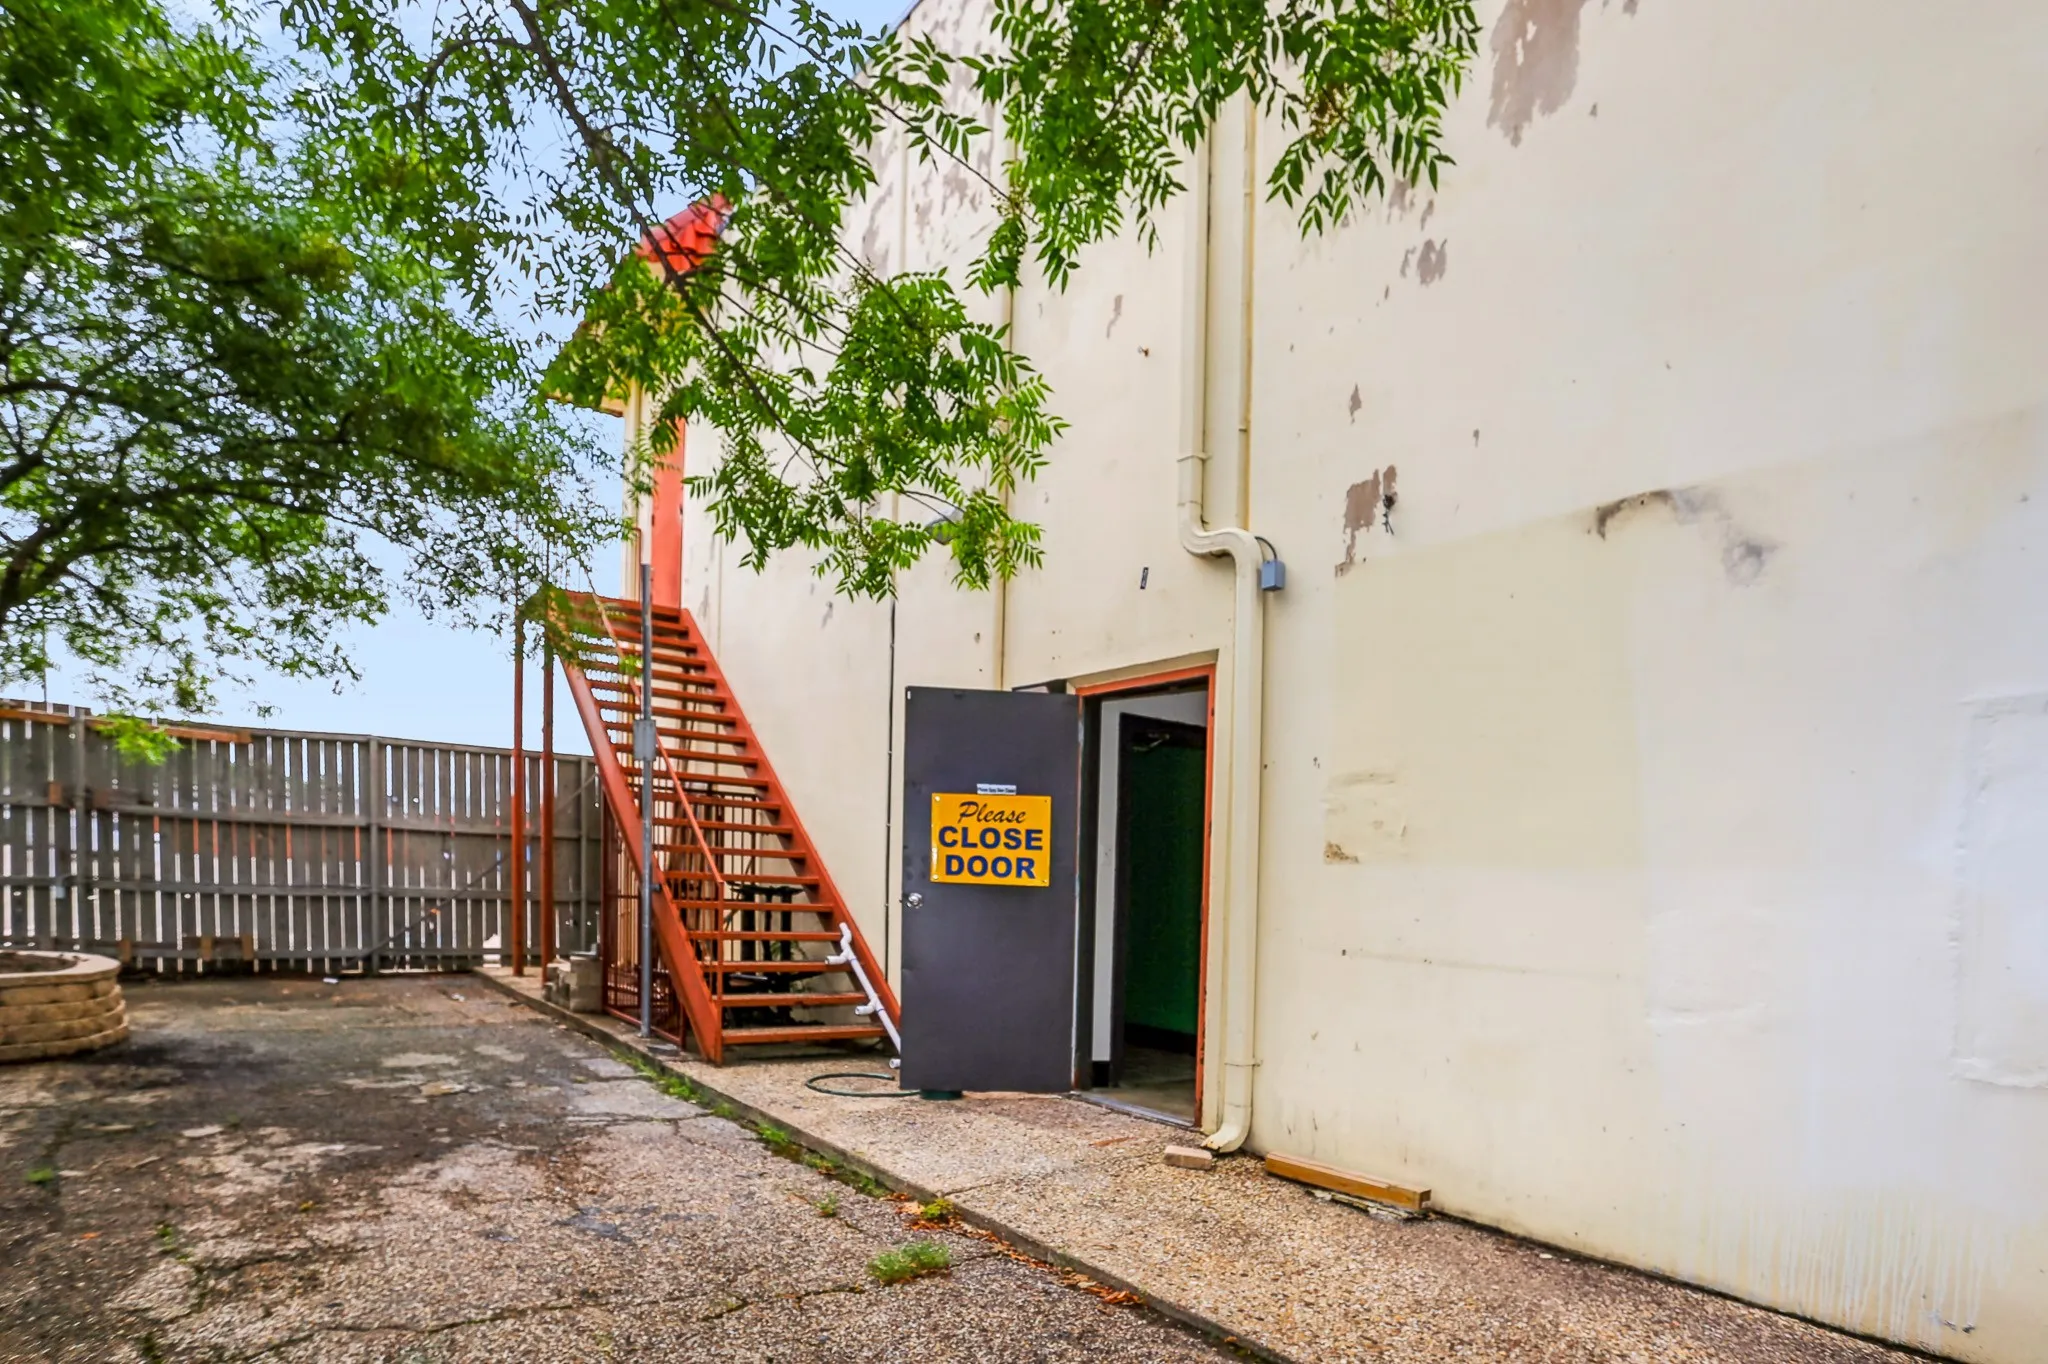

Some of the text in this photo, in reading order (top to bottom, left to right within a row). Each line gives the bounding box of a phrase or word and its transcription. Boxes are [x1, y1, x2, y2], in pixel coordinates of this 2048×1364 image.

[958, 801, 1026, 824] Please
[938, 826, 1043, 850] CLOSE
[945, 854, 1035, 879] DOOR
